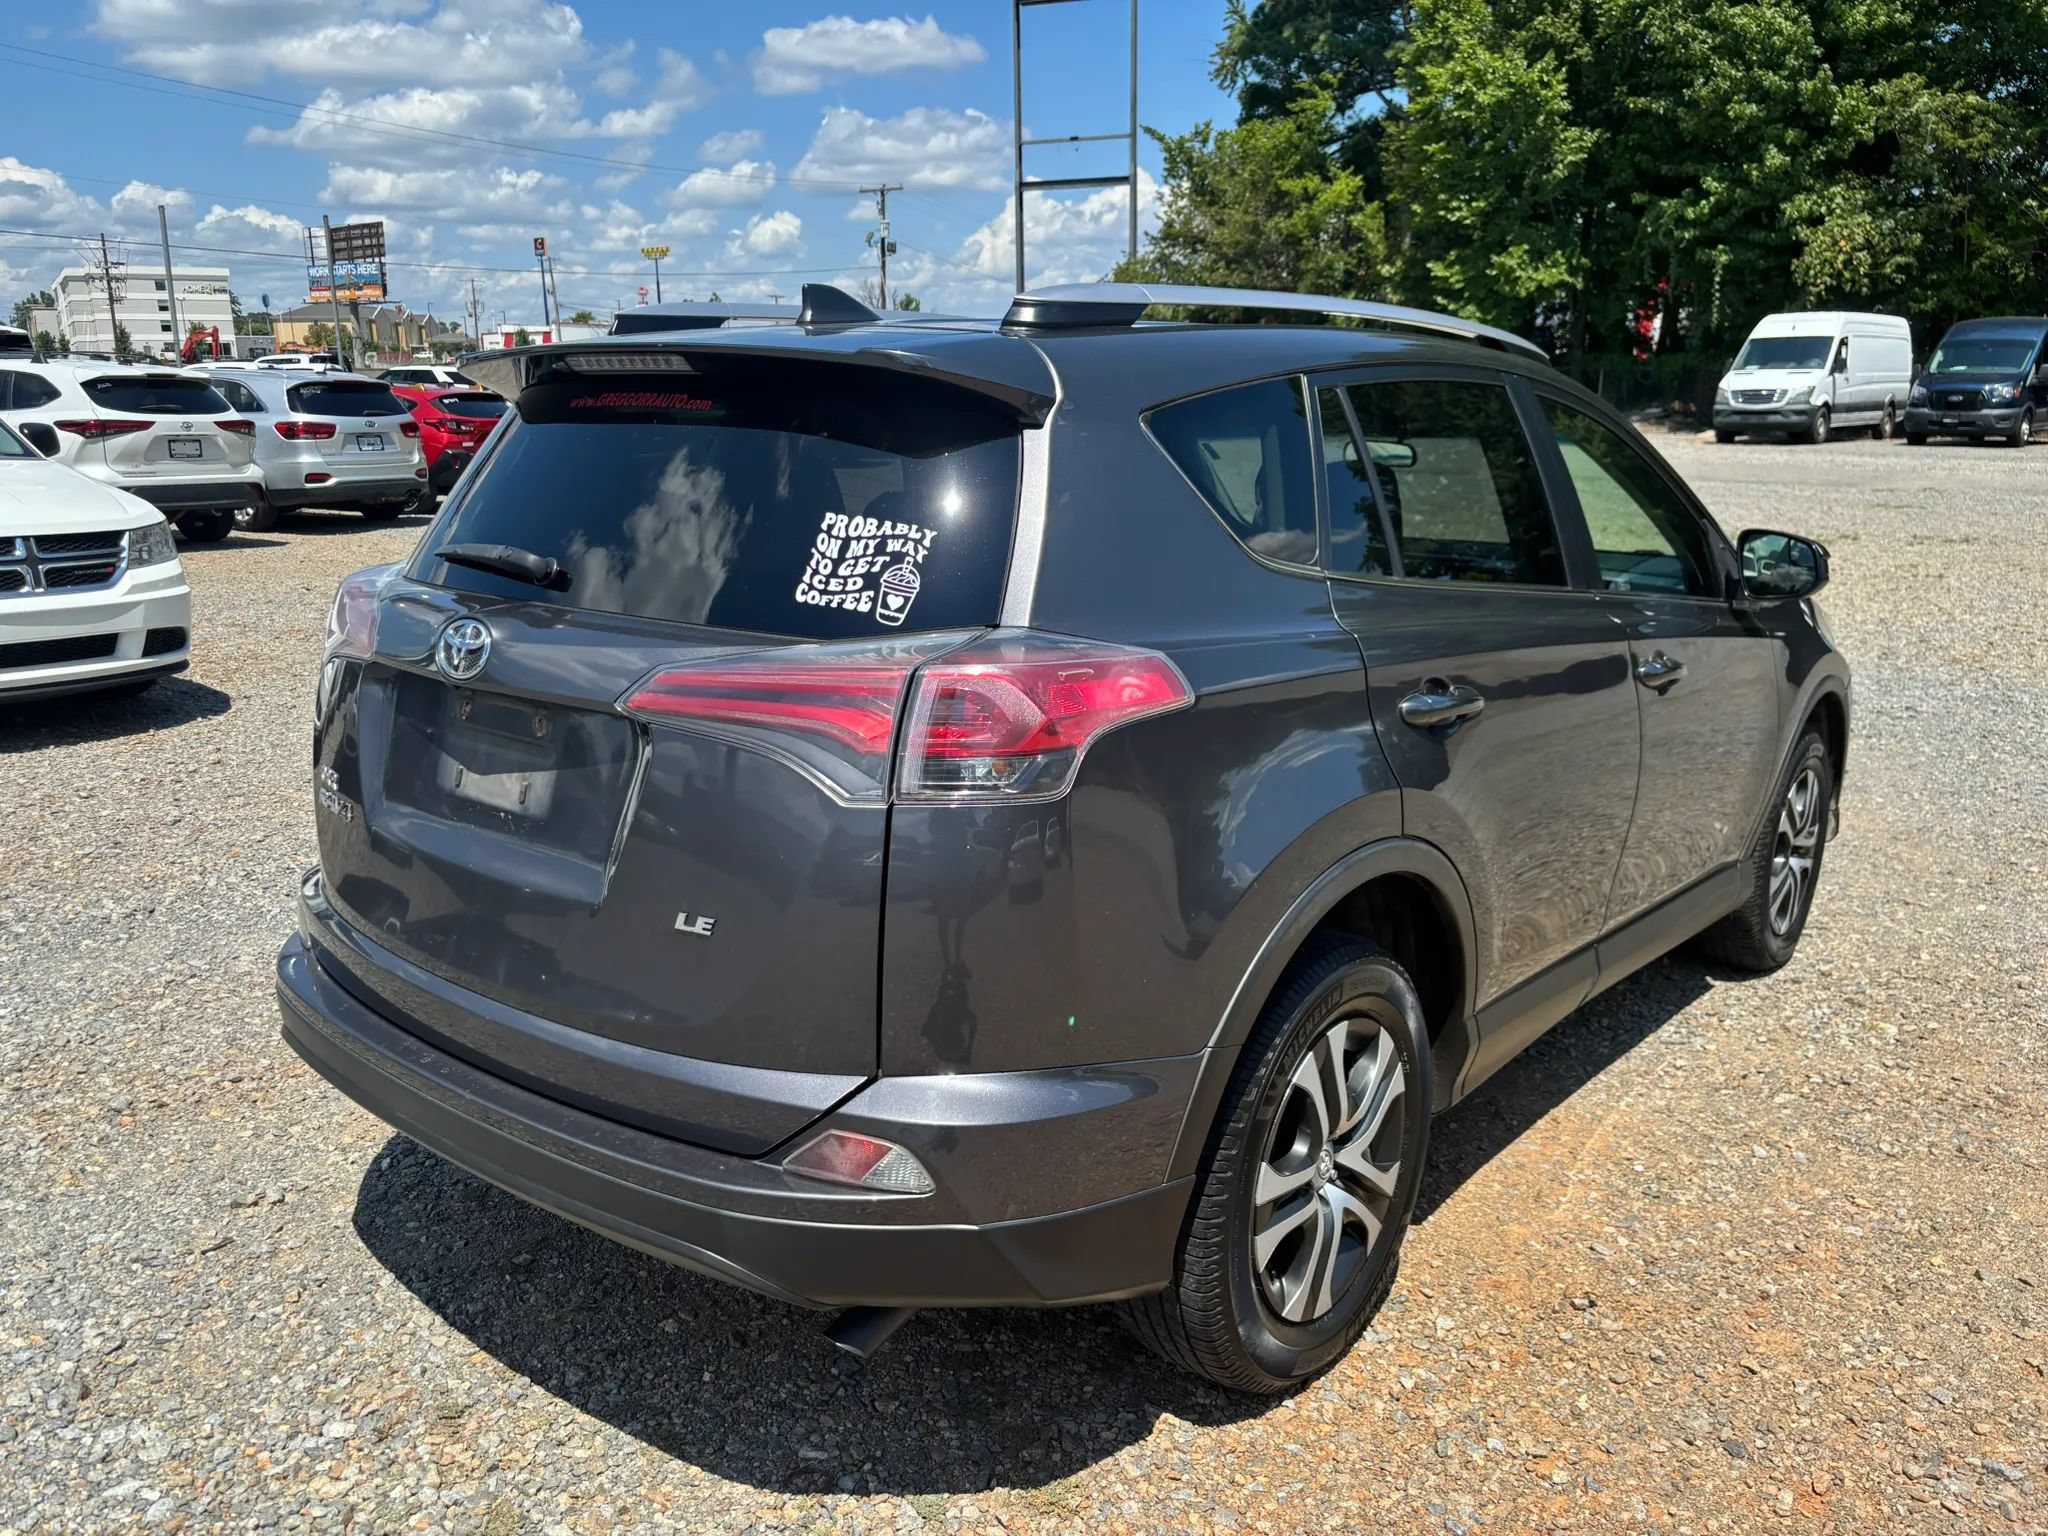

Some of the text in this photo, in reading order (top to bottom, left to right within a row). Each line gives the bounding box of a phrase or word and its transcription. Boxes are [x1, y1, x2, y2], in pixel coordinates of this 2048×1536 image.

[357, 263, 380, 274] HERE.
[820, 512, 938, 548] PROBABLY
[810, 548, 890, 577] TO GET
[816, 532, 928, 564] ON MY WAY
[802, 566, 864, 592] ICED
[795, 582, 874, 613] COFFEE
[674, 911, 717, 936] LE
